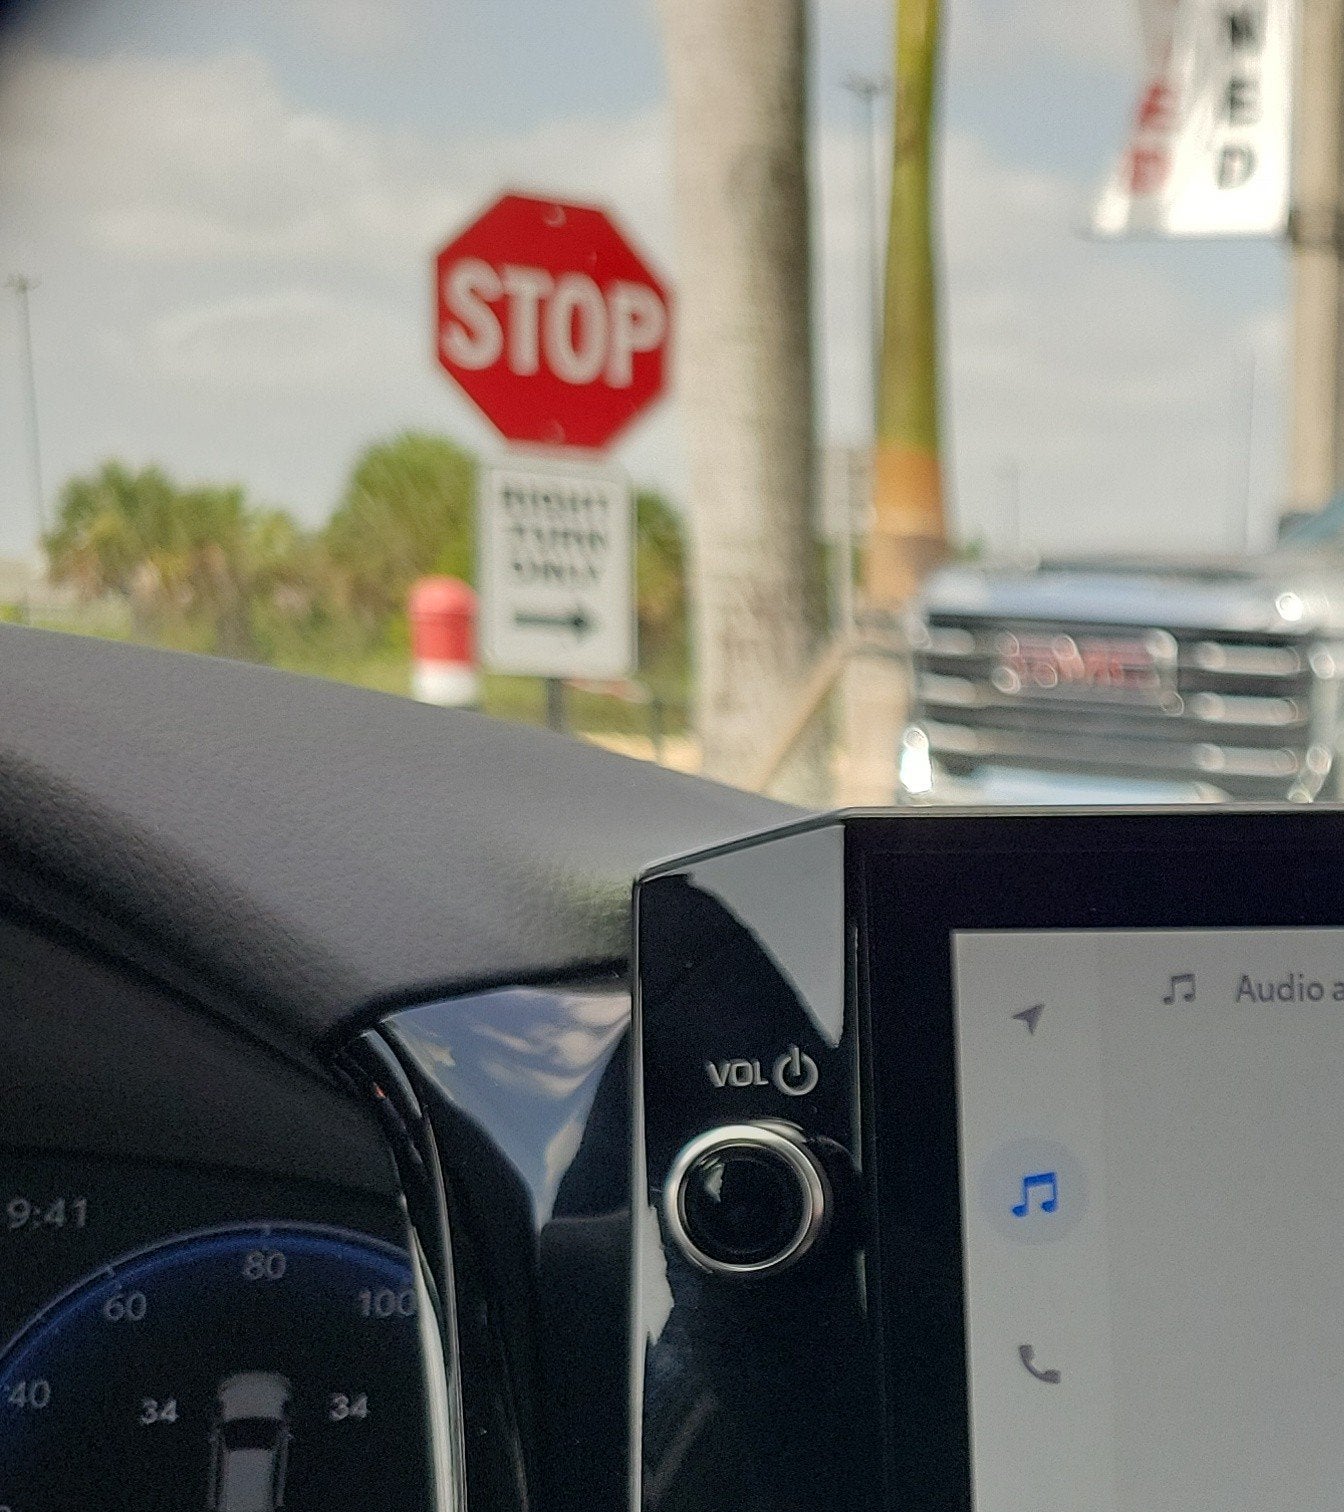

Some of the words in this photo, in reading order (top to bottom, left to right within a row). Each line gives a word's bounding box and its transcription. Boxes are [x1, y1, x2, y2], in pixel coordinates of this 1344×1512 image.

[440, 257, 670, 390] STOP
[1236, 973, 1326, 1004] Audio
[705, 1059, 769, 1089] VOL
[6, 1197, 88, 1230] 9:41
[242, 1249, 288, 1281] 80
[104, 1291, 148, 1322] 60
[357, 1288, 415, 1318] 100
[8, 1379, 51, 1410] 40
[328, 1391, 370, 1422] 34
[139, 1397, 179, 1425] 34
